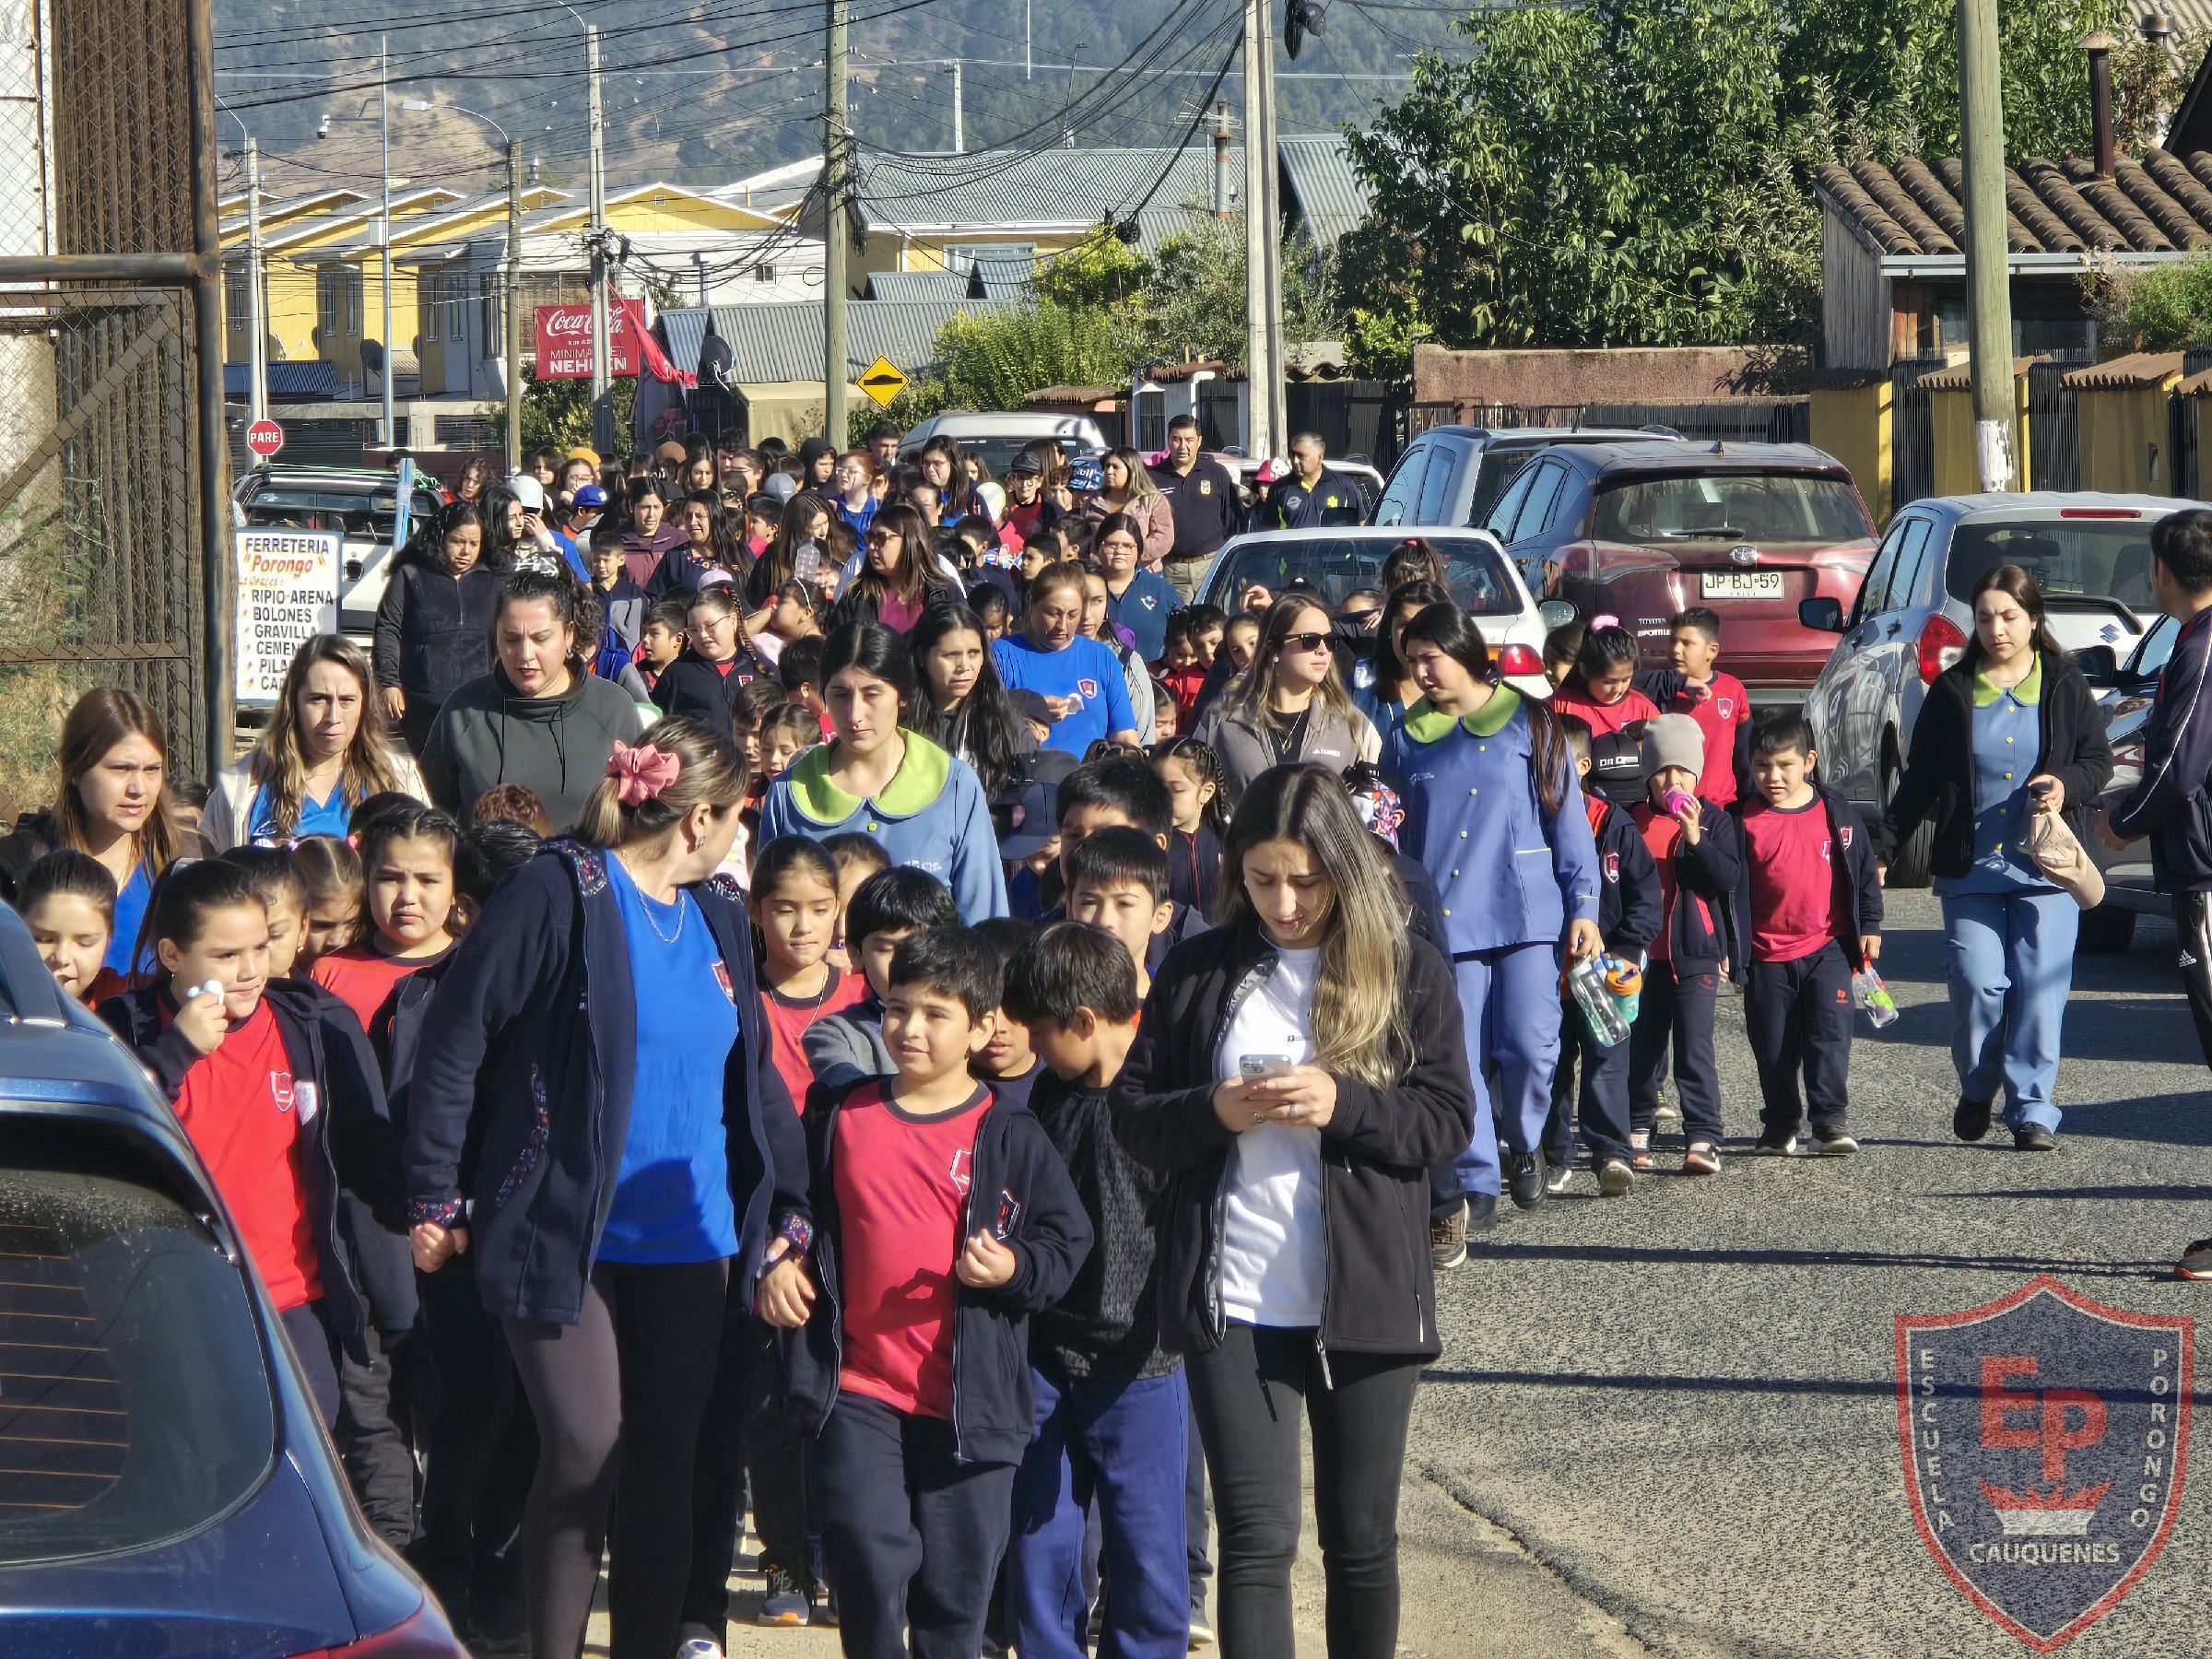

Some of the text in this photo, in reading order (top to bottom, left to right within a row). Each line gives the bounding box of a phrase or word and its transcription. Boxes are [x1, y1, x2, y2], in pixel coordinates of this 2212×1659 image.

[550, 346, 625, 359] MINIMAET
[550, 357, 627, 374] NEHN
[250, 431, 279, 444] PARE
[245, 537, 329, 555] FERRETERIA
[253, 606, 312, 623] BOLONES
[254, 624, 317, 639] GRAVILLA
